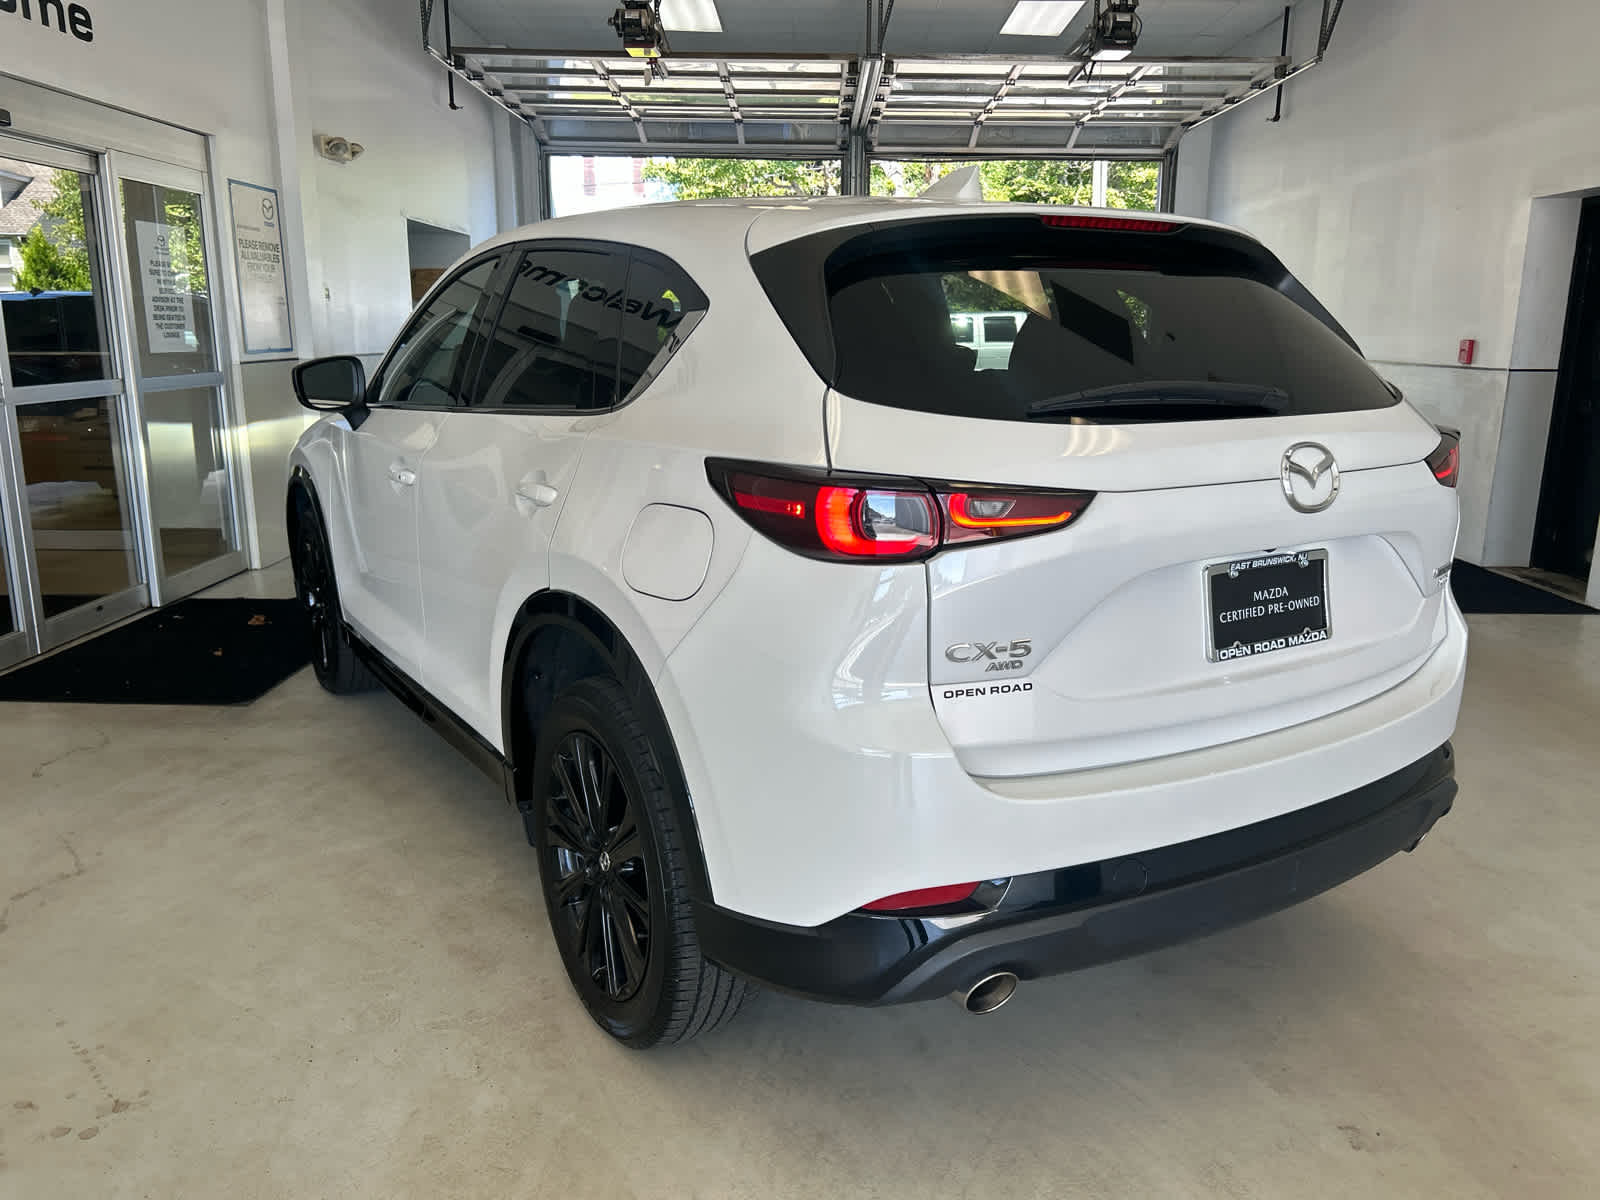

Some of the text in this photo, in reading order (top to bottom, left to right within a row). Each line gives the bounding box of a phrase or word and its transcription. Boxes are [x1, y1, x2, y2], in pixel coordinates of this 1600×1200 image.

[238, 238, 280, 253] PLEASE REMOVE
[1230, 553, 1308, 571] EAST BRUNSWICK, NJ
[1253, 586, 1289, 602] MAZDA
[1219, 595, 1320, 624] CERTIFIED PRE-OWNED
[944, 638, 1032, 664] CX-5
[1219, 630, 1327, 661] OPEN ROAD MAZDA
[984, 659, 1024, 673] AWD
[943, 682, 1033, 699] OPEN ROAD
